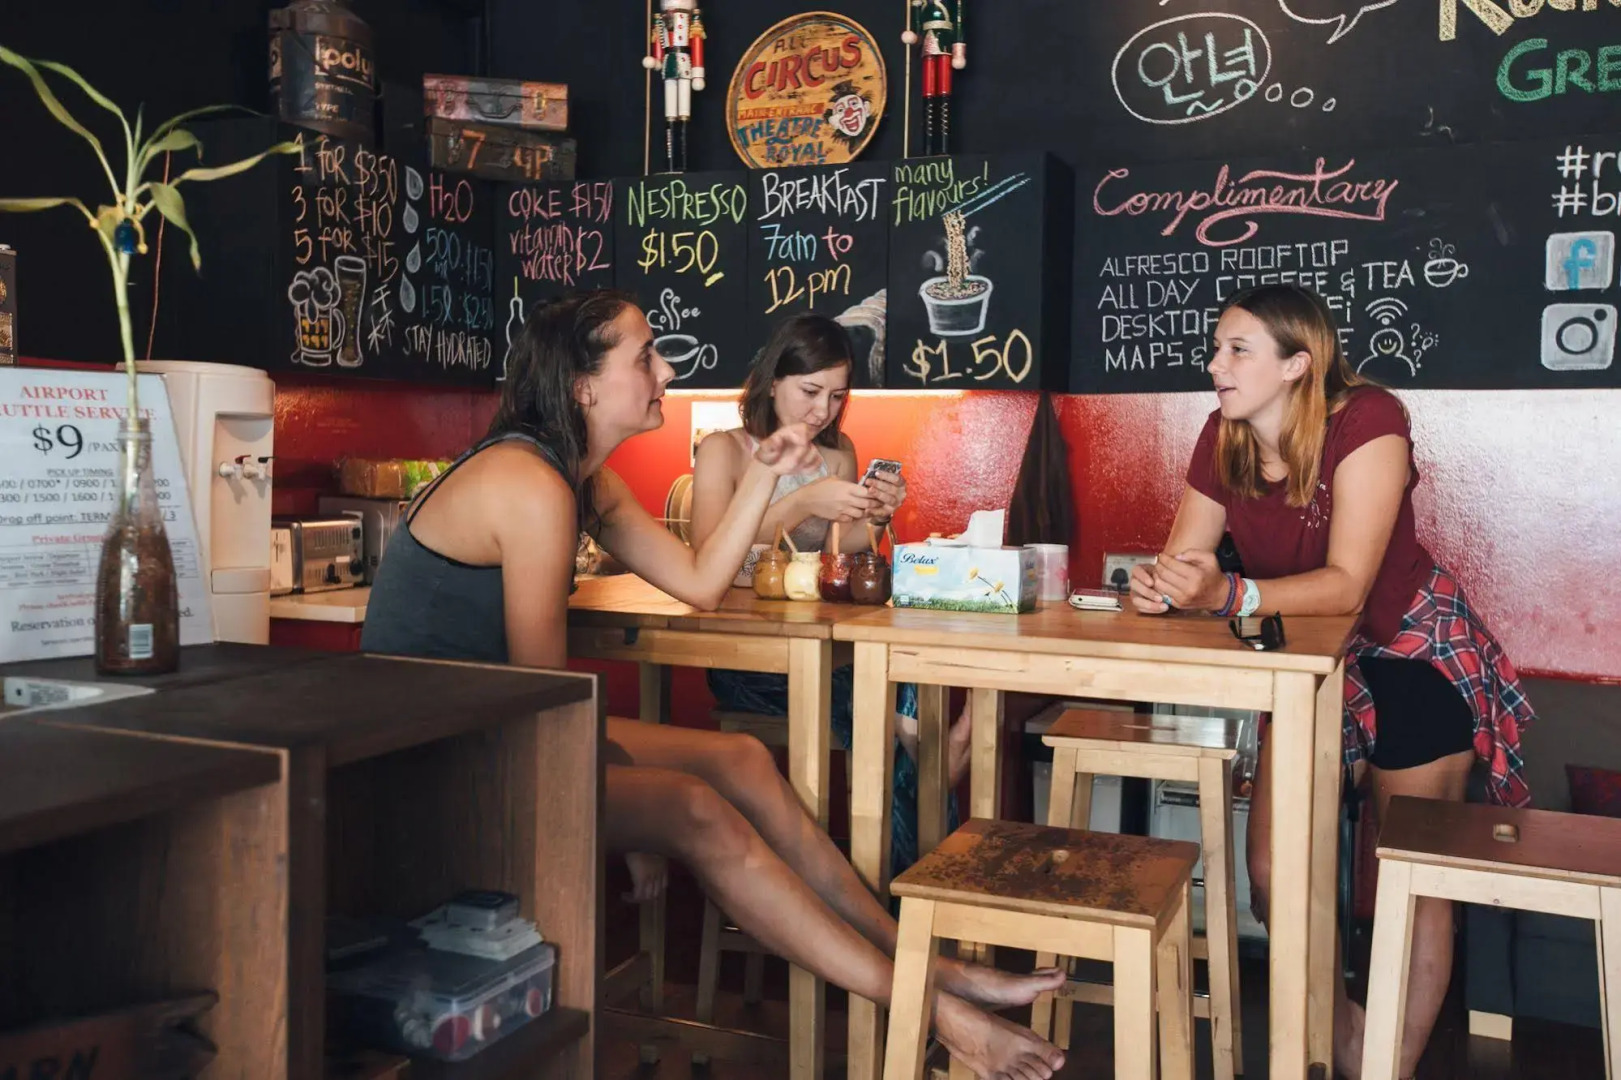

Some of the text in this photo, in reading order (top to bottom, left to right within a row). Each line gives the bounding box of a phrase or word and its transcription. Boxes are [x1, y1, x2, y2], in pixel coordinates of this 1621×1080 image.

[745, 35, 862, 99] CIRCUS
[737, 117, 825, 147] THEATRE
[765, 141, 827, 163] ROYAL
[1556, 145, 1621, 179] #r
[895, 158, 954, 191] many
[291, 186, 307, 222] 3
[353, 194, 392, 238] $10
[508, 187, 562, 220] COKE
[628, 179, 747, 227] NESPRESSO
[757, 168, 886, 221] BREAKFAST
[1094, 157, 1398, 246] Complimentary
[294, 228, 313, 265] 5
[361, 232, 399, 283] $15
[575, 226, 610, 276] $2
[637, 228, 719, 275] $1.50
[760, 223, 853, 261] 7am to
[1099, 240, 1348, 277] ALFRESCO ROOFTOP
[1098, 283, 1139, 309] ALL
[1147, 278, 1200, 306] DAY
[1362, 259, 1415, 290] TEA
[403, 324, 492, 370] STAY HYDRATED
[903, 328, 1033, 386] $1.50
[1105, 337, 1208, 373] MAPS &
[0, 403, 157, 420] UTTLE SERVE
[20, 386, 108, 401] AIRPORT
[32, 422, 84, 460] $9
[73, 479, 100, 488] 0900
[84, 468, 114, 477] TIMING
[34, 493, 61, 502] 1500
[27, 513, 43, 523] off
[80, 513, 111, 522] TERM
[11, 616, 86, 633] Reservation
